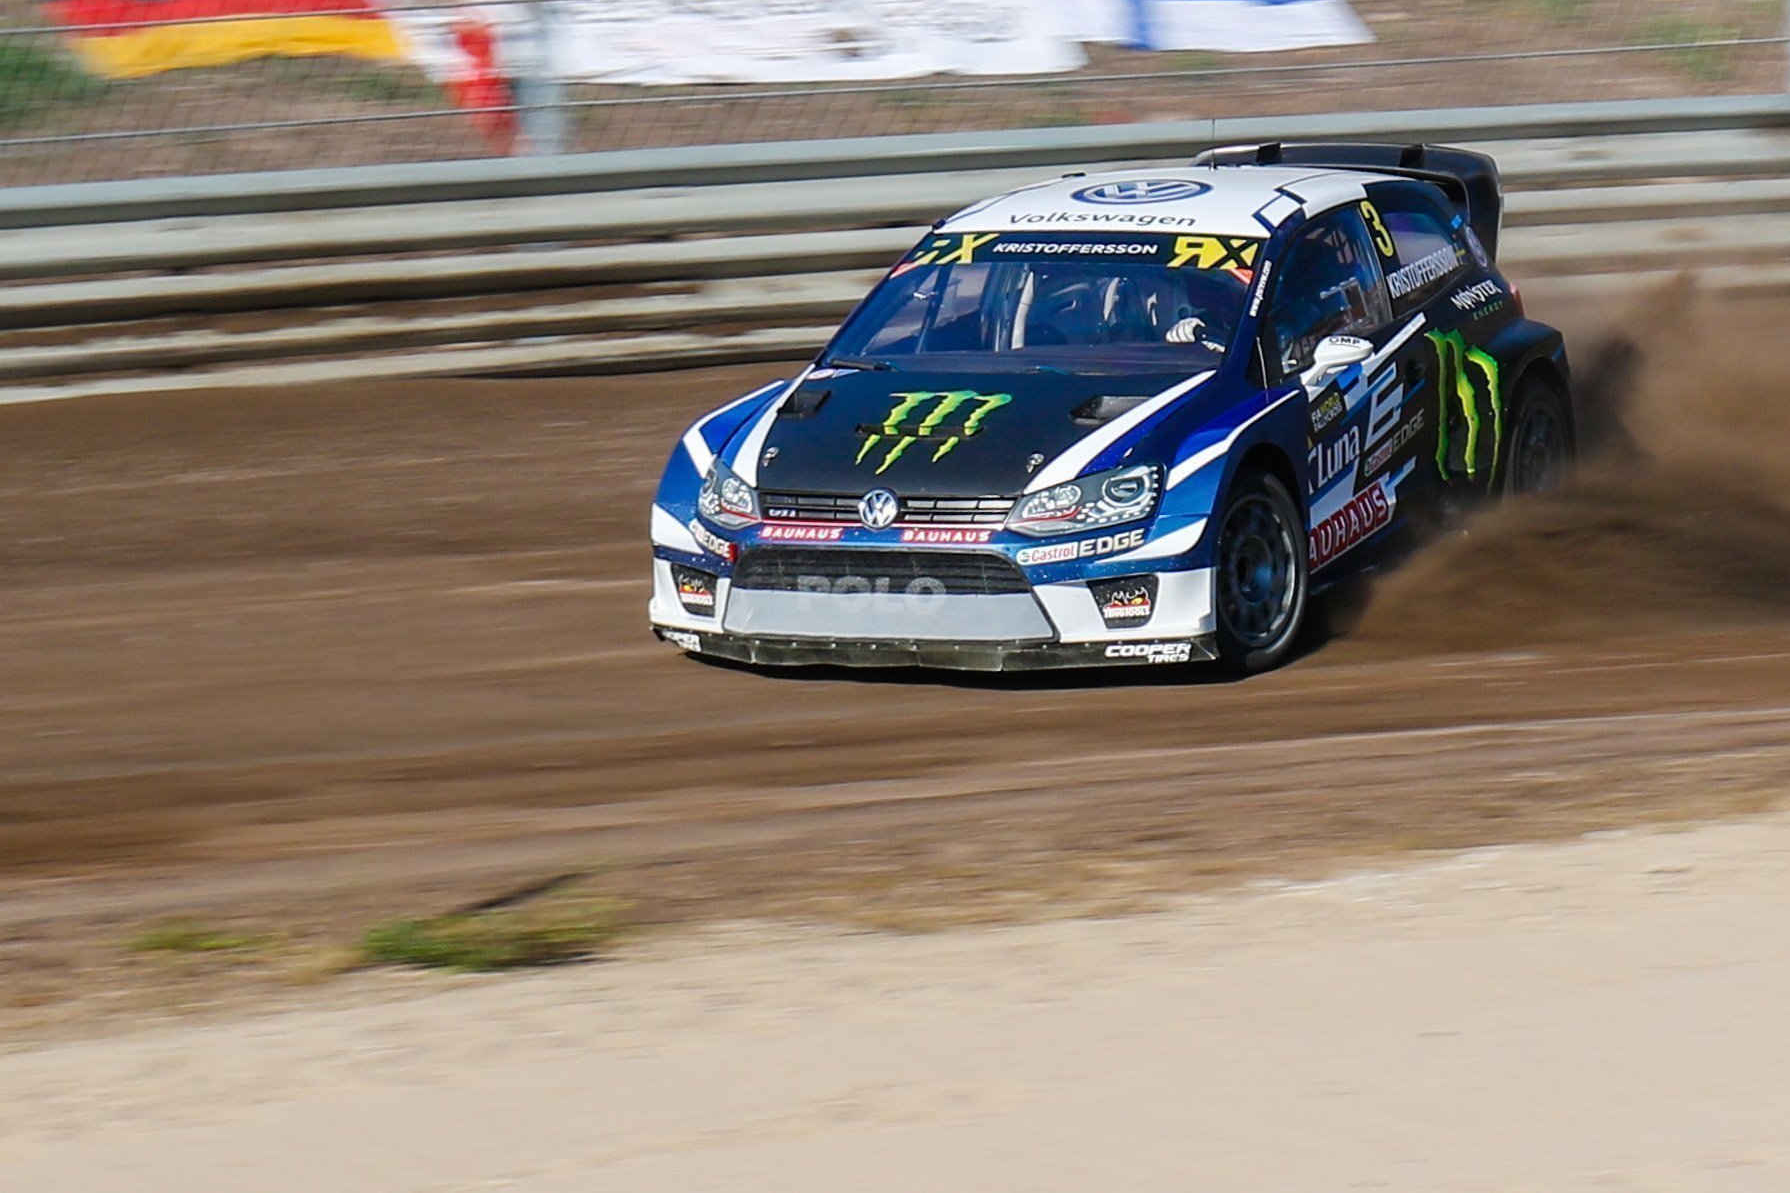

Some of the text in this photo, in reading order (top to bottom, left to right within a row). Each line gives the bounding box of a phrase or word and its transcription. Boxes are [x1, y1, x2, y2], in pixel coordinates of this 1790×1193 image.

[1009, 211, 1197, 228] Volkswagen
[1360, 200, 1394, 257] 3
[992, 242, 1159, 256] KRISTOFFERSSON
[1386, 245, 1460, 300] KRISTOFFERSSON
[1393, 407, 1426, 455] EDGE
[1317, 424, 1361, 486] Luna
[760, 526, 843, 540] BAUHAUS
[903, 530, 991, 543] BAUHAUS
[1309, 487, 1388, 562] AUHAUS
[1031, 528, 1145, 563] Castrol EDGE
[797, 575, 948, 615] POLO
[1104, 643, 1193, 659] COOPER
